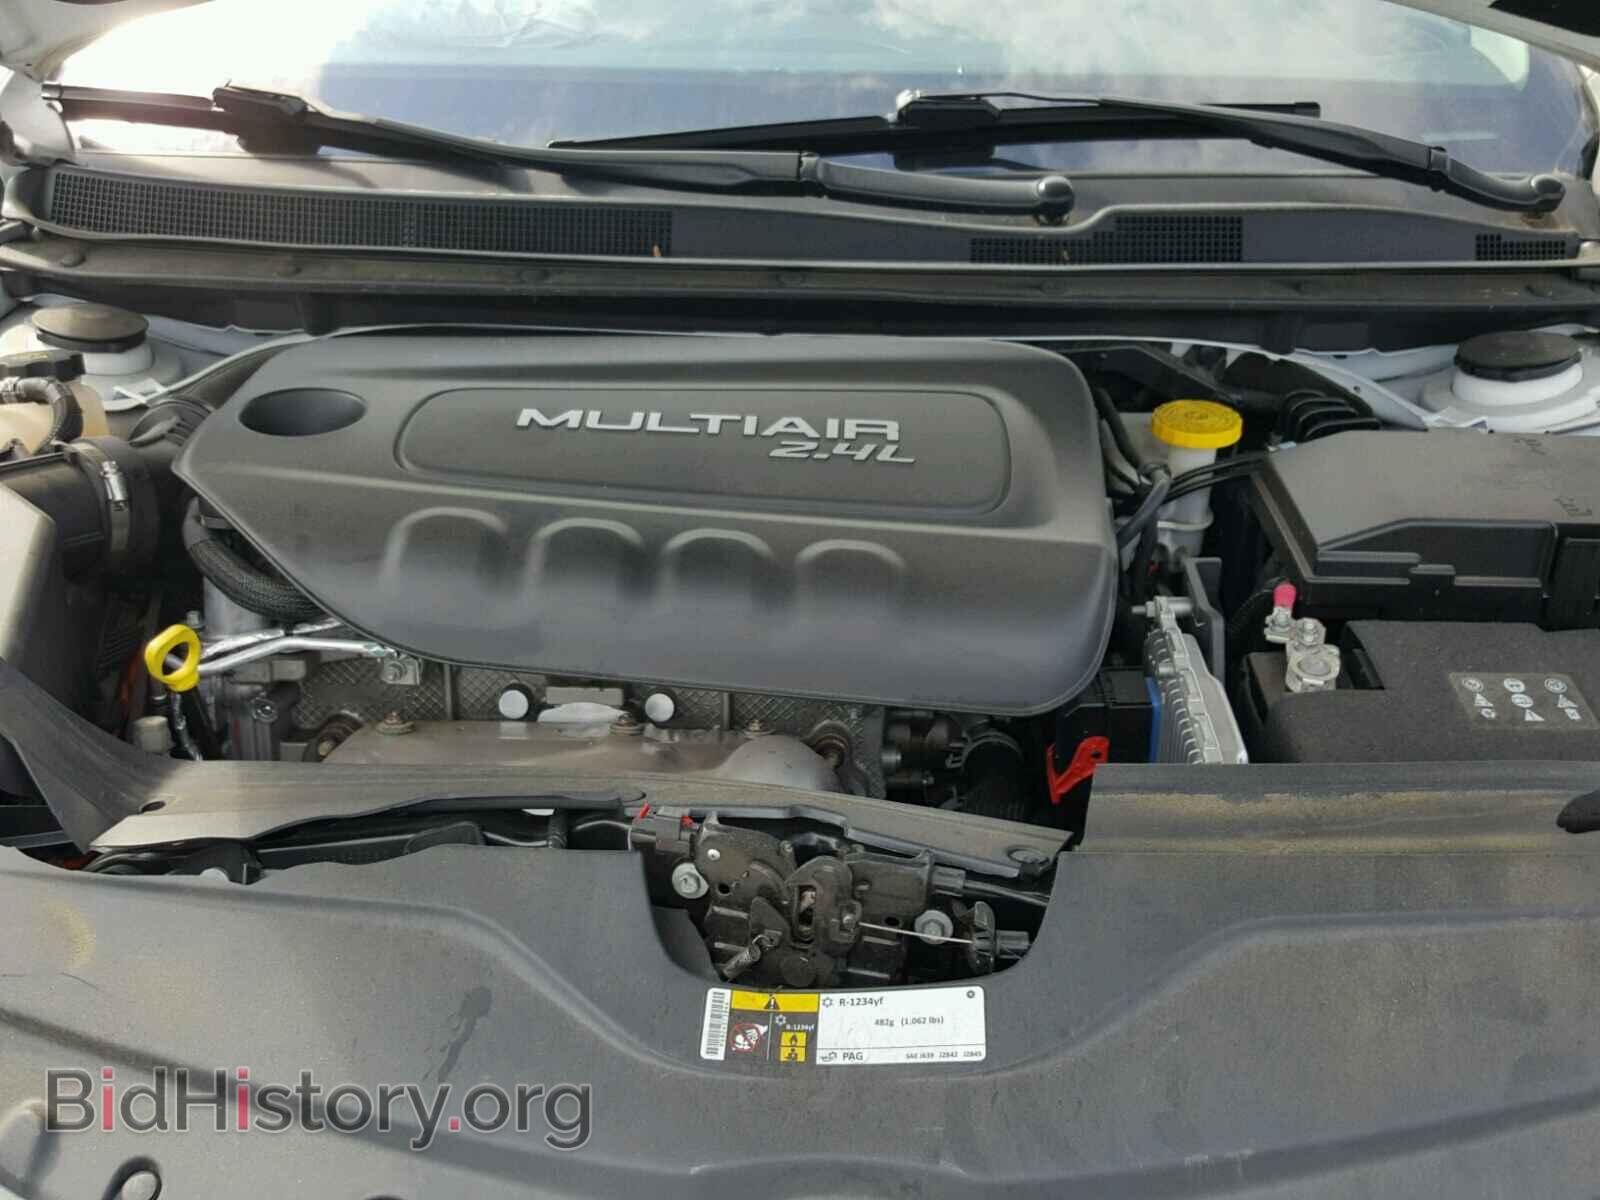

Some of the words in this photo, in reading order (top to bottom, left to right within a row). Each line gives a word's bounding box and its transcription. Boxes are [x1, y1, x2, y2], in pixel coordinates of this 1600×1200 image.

[515, 408, 900, 441] MULTIAIR
[768, 441, 916, 464] 2.4L
[839, 997, 884, 1007] R-1234yf
[842, 1051, 864, 1061] PAG
